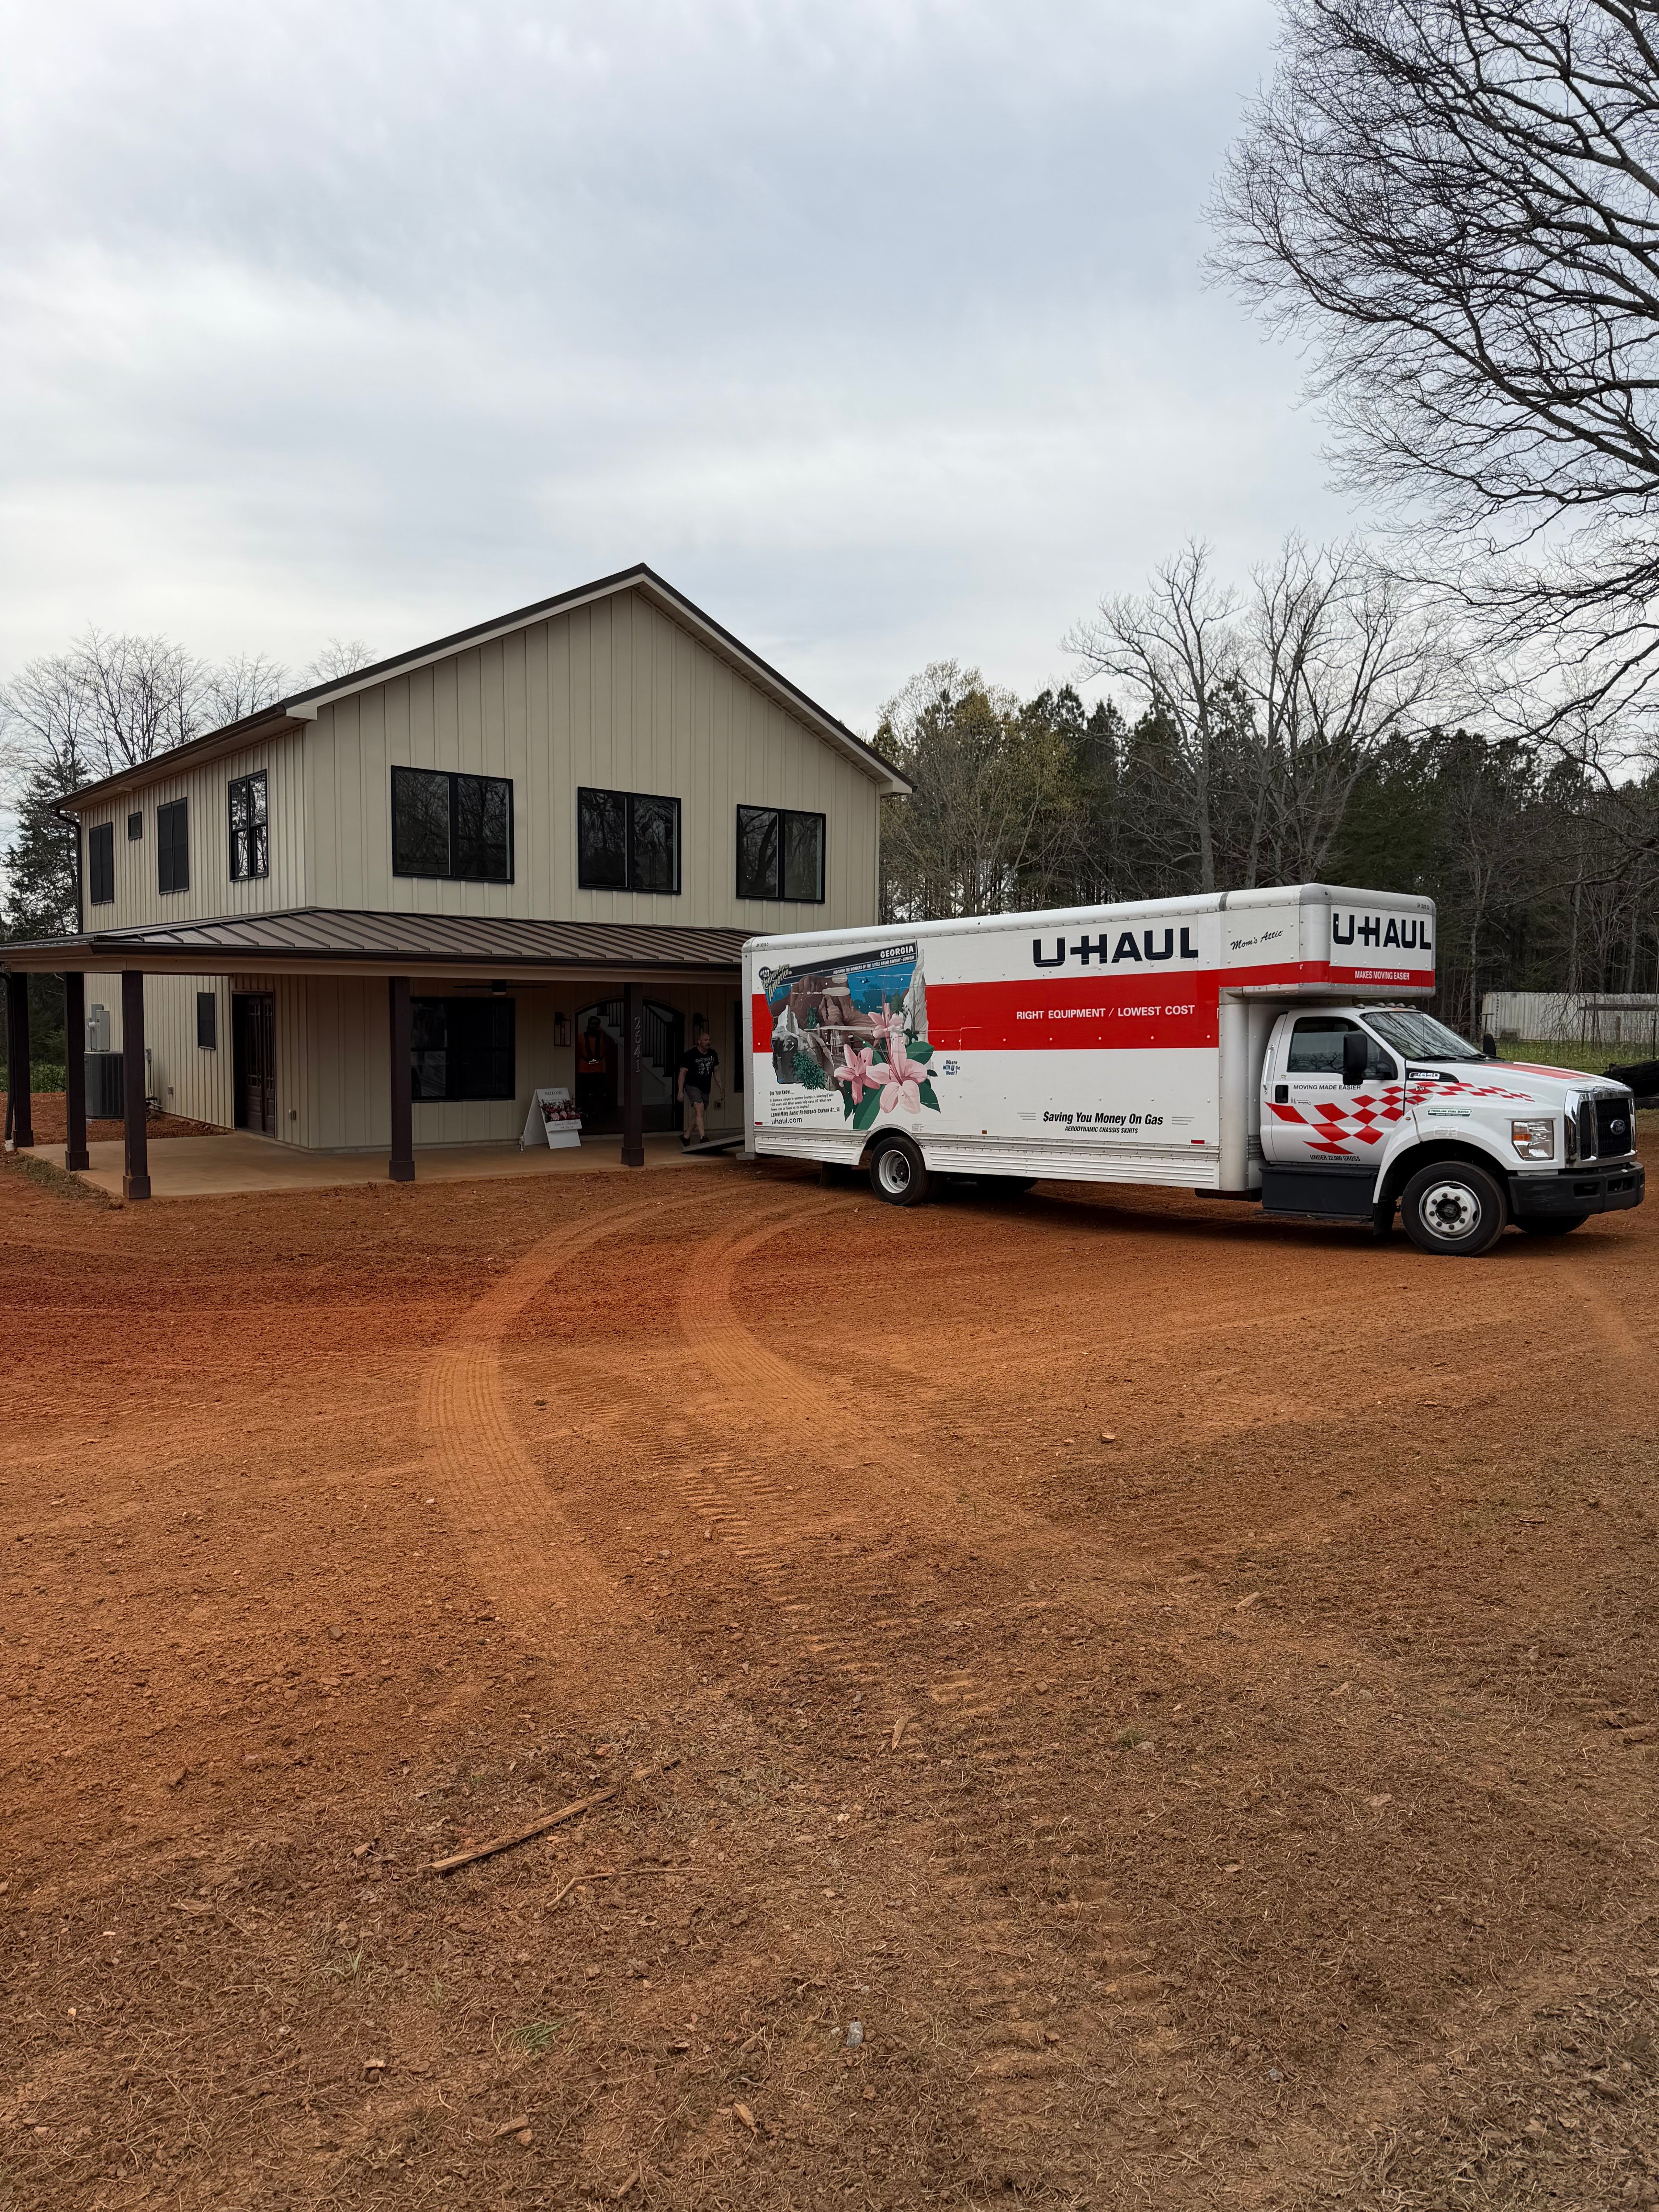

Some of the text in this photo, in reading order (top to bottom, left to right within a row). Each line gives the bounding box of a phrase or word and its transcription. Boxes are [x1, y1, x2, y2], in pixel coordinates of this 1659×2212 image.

[1333, 913, 1431, 950] U-HAUL
[1033, 927, 1199, 968] U-HAUL
[1230, 930, 1283, 950] Mom's Attic
[880, 945, 914, 958] GEORGIA
[1355, 970, 1410, 981] MAKES MOVING EASIER
[1016, 1011, 1044, 1020] RIGHT
[1048, 1008, 1106, 1019] EQUIPMENT
[1118, 1006, 1161, 1017] LOWEST
[1165, 1005, 1195, 1015] COST
[1043, 1111, 1163, 1126] $aving You Money On Gas
